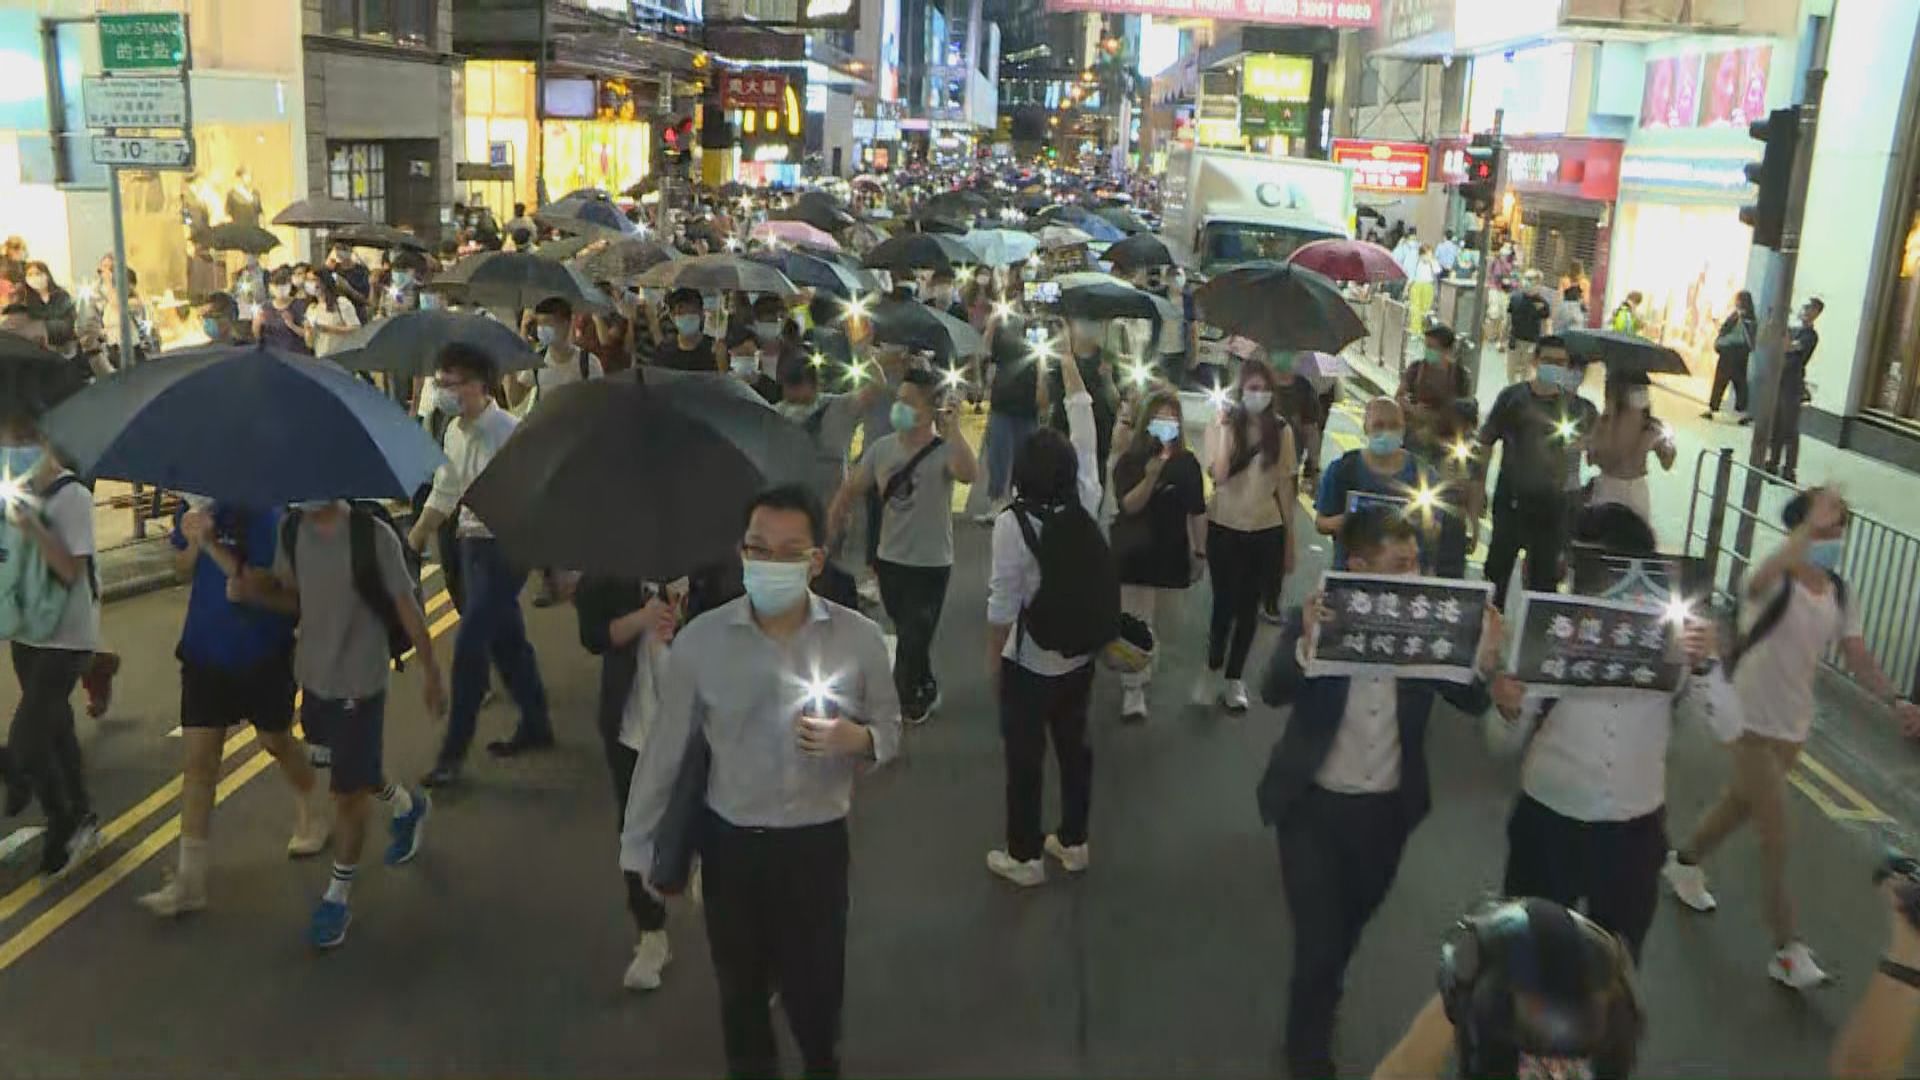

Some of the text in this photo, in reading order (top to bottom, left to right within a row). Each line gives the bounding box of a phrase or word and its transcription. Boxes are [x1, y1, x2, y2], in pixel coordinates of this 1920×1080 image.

[135, 22, 179, 36] STAND
[116, 40, 171, 60] 的士站
